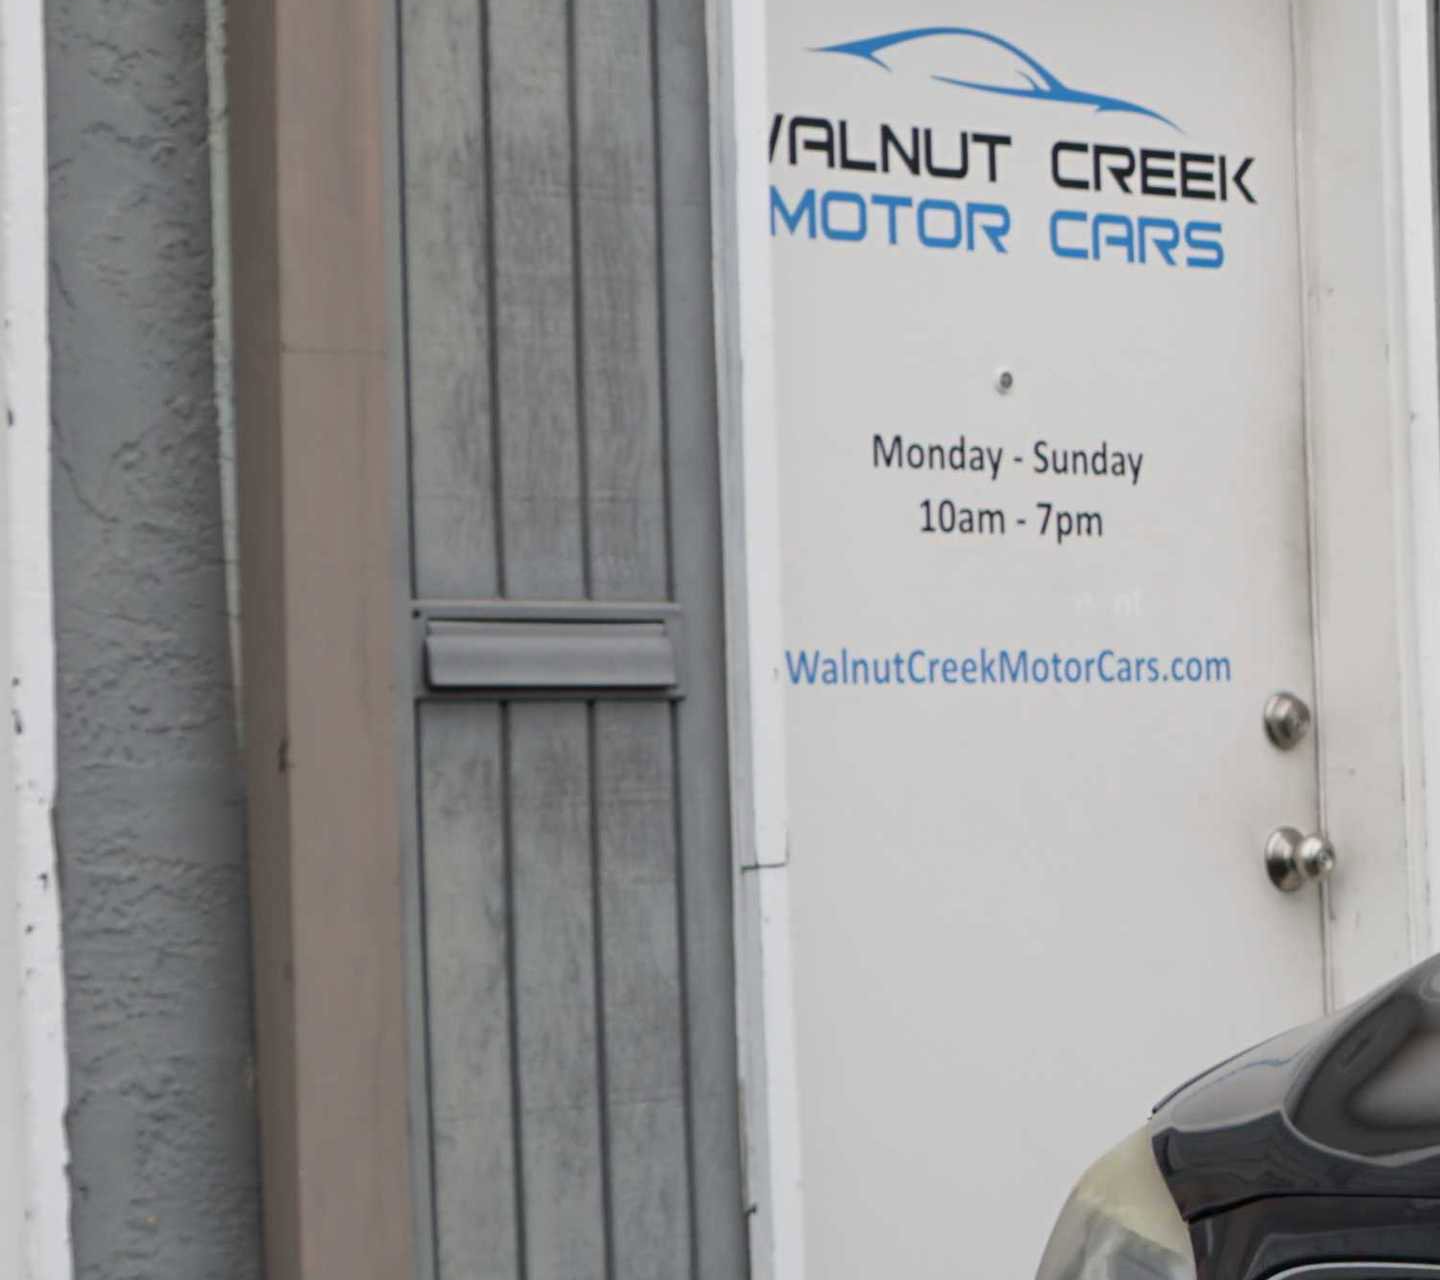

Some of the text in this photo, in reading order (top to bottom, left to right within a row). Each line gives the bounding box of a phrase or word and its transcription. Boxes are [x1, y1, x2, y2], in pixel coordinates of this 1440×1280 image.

[1051, 140, 1257, 204] CREEK
[769, 184, 1224, 269] MOTOR CARS
[872, 433, 1003, 481] Monday
[1033, 440, 1143, 485] Sunday
[919, 499, 1006, 535] 10am
[1036, 503, 1103, 544] 7pm
[784, 648, 1232, 686] WalnutCreekMotorCars.com
